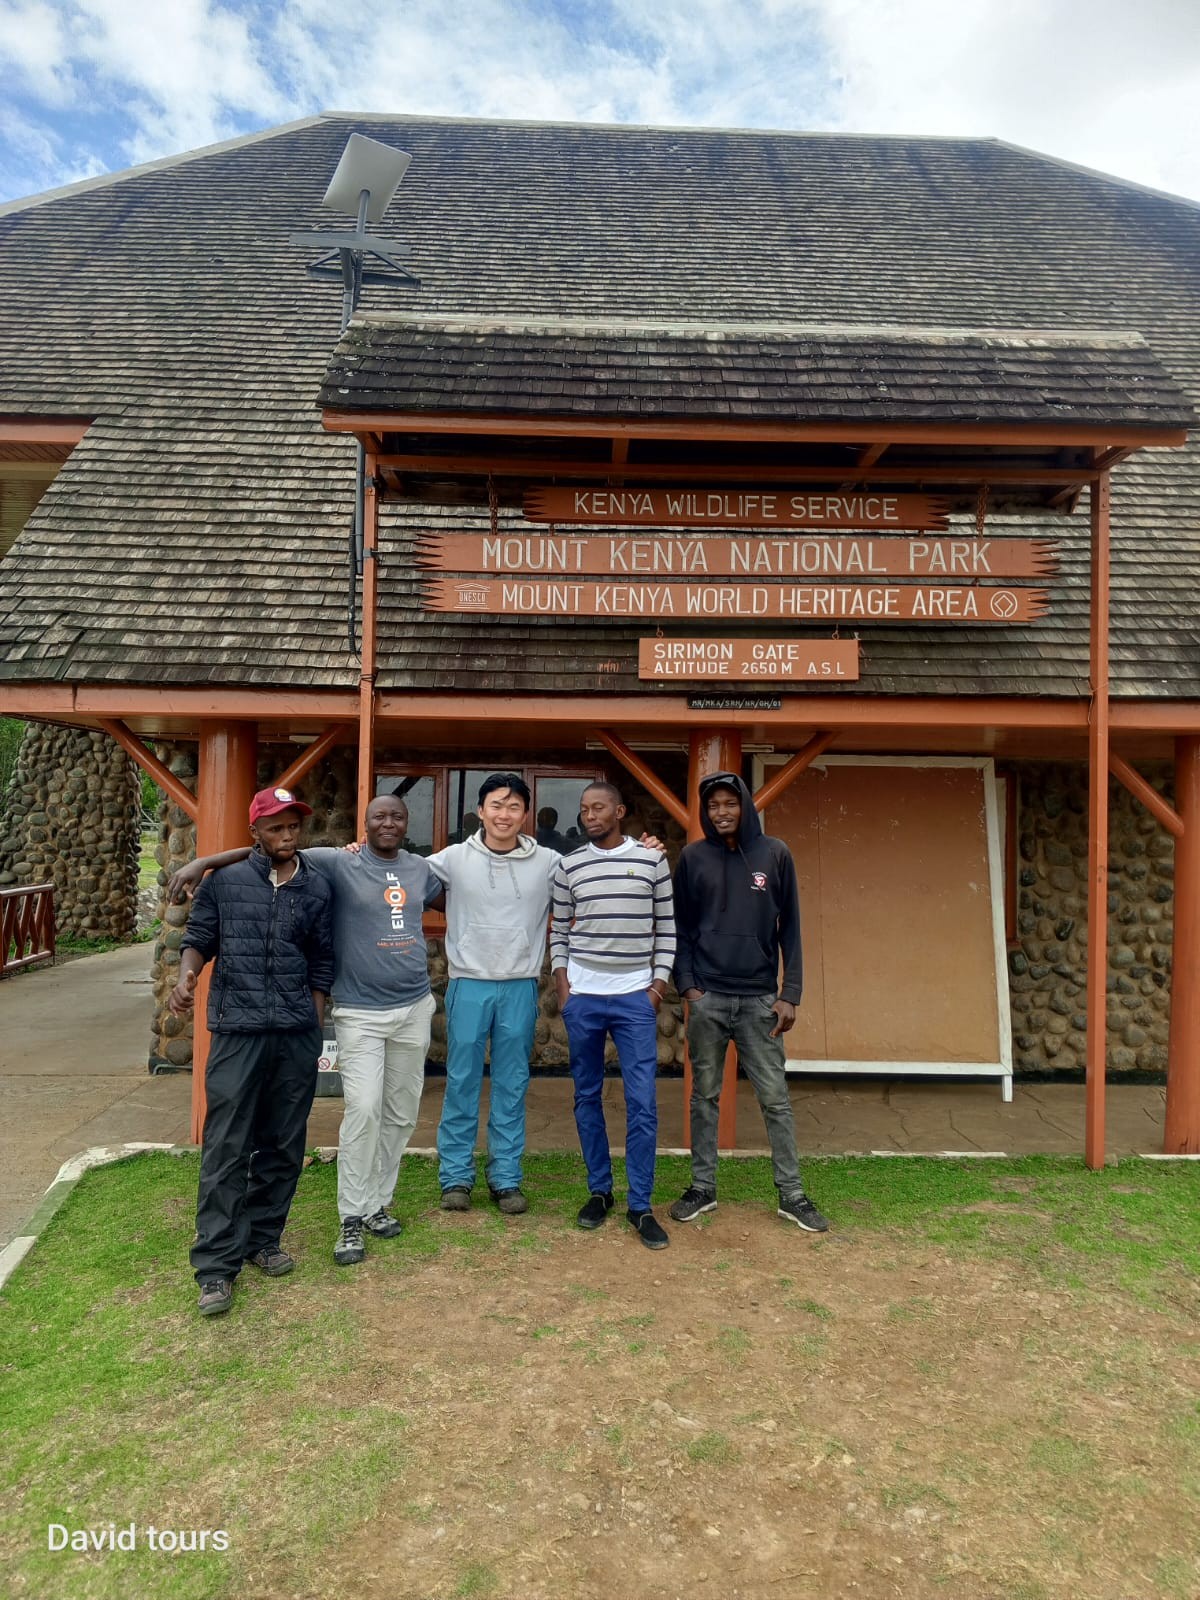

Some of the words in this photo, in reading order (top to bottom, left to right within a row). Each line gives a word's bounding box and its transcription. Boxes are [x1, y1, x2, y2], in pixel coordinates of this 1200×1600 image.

[574, 492, 655, 515] KENYA
[666, 494, 777, 518] WILDLIFE
[790, 496, 899, 520] SERVICE
[482, 538, 588, 570] MOUNT
[609, 540, 709, 572] KENYA
[730, 541, 887, 572] NATIONAL
[908, 541, 992, 573] PARK
[459, 591, 486, 602] UNESCO
[502, 583, 584, 611] MOUNT
[594, 586, 674, 613] KENYA
[686, 587, 768, 614] WORLD
[779, 588, 900, 615] HERITAGE
[911, 590, 978, 617] AREA
[654, 643, 733, 659] SIRIMON
[752, 644, 800, 660] GATE
[654, 661, 729, 674] ALTITUDE
[386, 872, 404, 929] EINOLF
